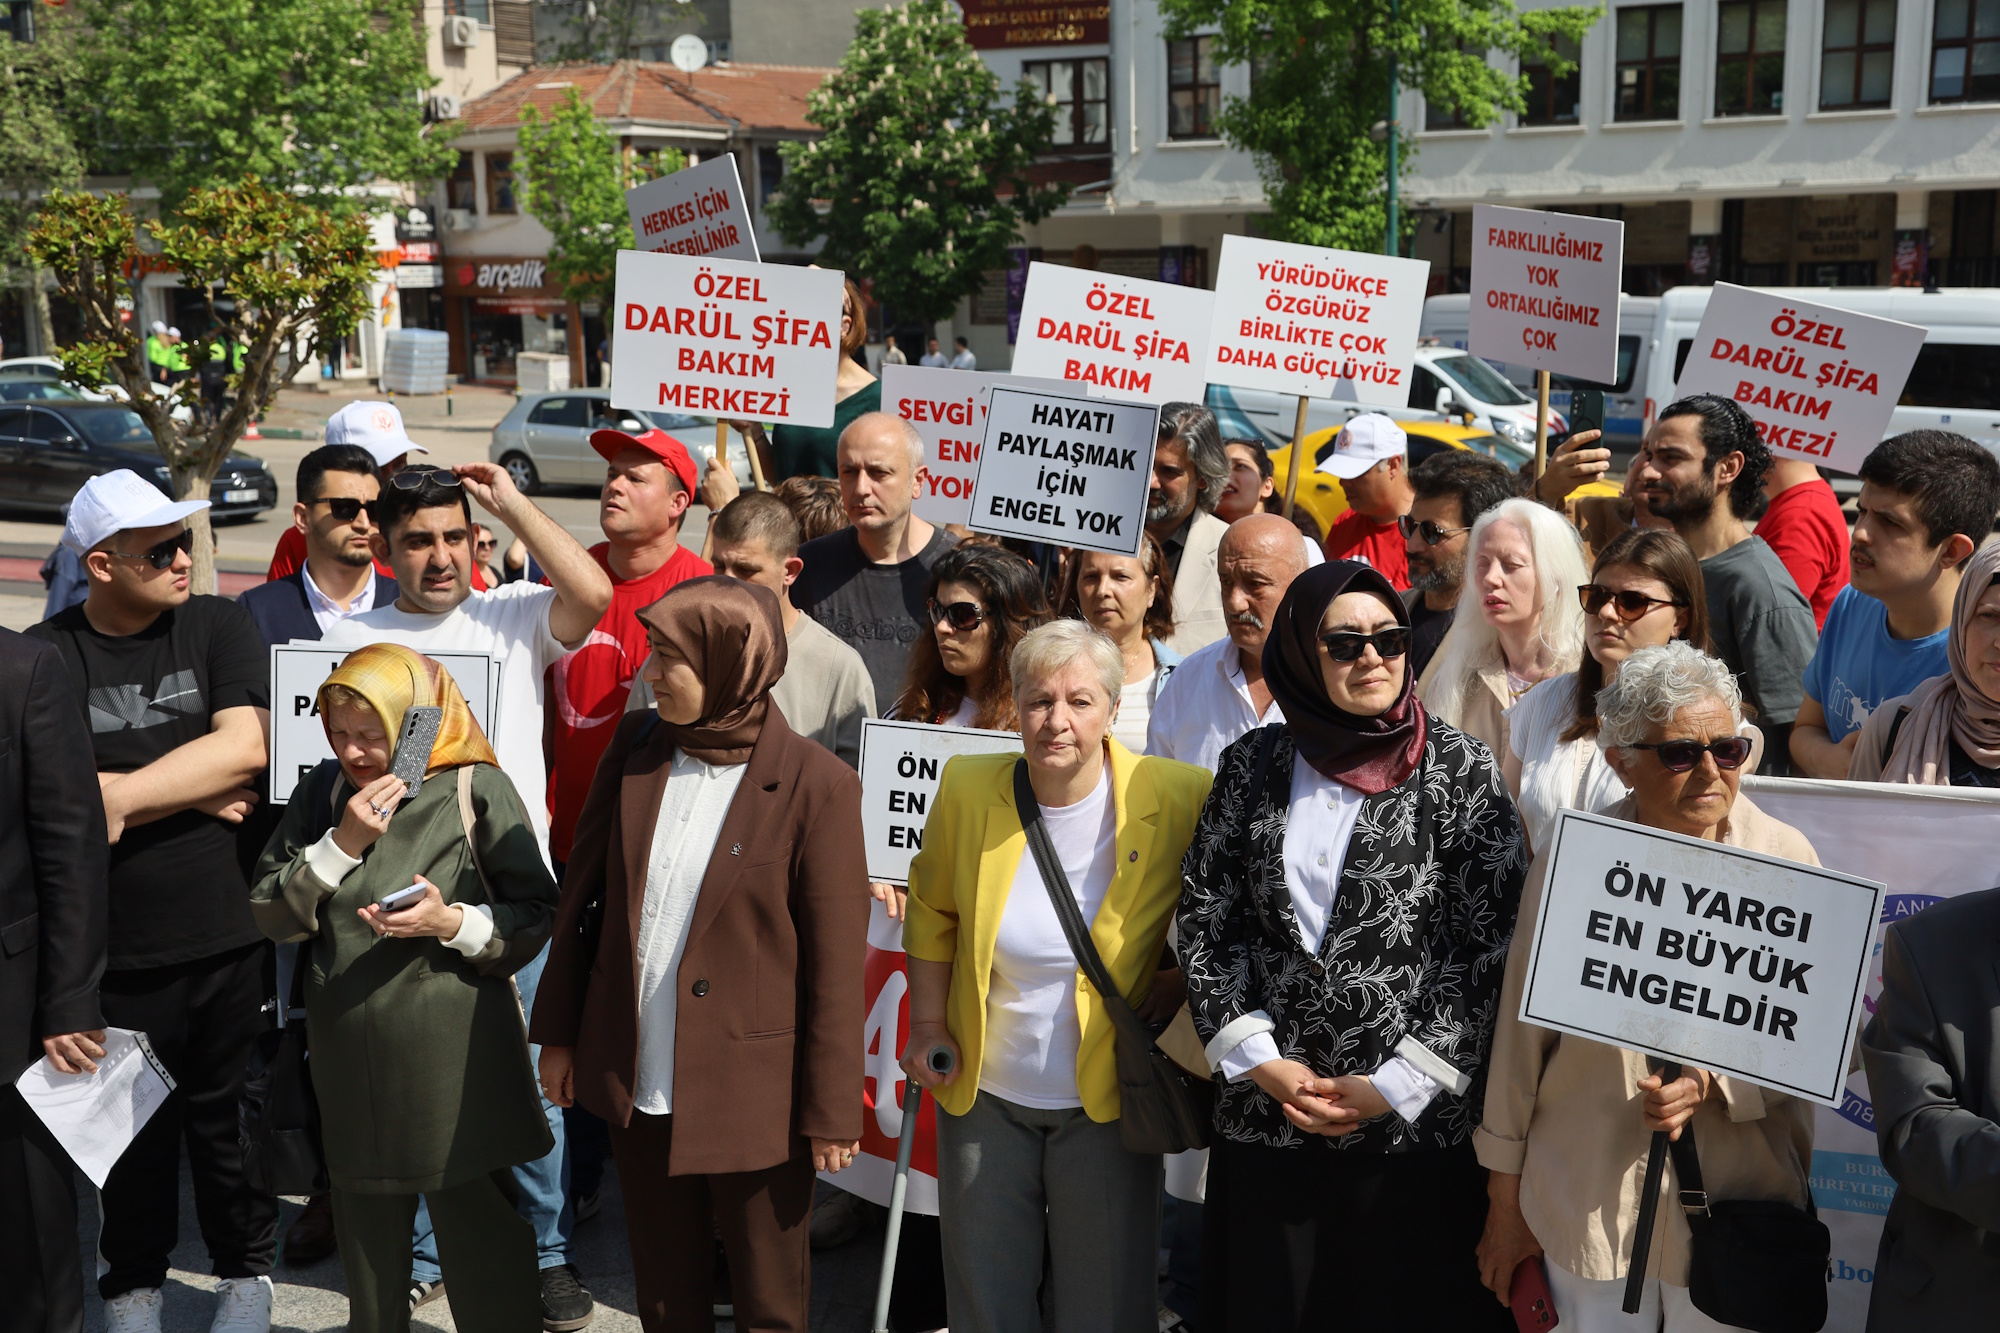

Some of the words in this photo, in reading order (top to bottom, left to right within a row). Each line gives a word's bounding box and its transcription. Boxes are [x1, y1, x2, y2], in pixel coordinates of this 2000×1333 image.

[641, 201, 696, 236] HERKES
[694, 187, 730, 220] İÇİN
[649, 220, 740, 256] İEBİLİNİR
[1487, 227, 1604, 262] FARKLILIĞIMIZ
[478, 259, 545, 294] arçelik
[693, 266, 768, 302] ÖZEL
[1257, 259, 1389, 298] YÜRÜDÜKÇE
[1526, 264, 1559, 288] YOK
[1085, 281, 1156, 320] ÖZEL
[1265, 287, 1371, 324] ÖZGÜRÜZ
[1486, 289, 1600, 327] ORTAKLIĞIMIZ
[625, 301, 741, 340] DARÜL
[752, 309, 832, 351] ŞİFA
[1036, 316, 1126, 352] DARÜL
[1132, 329, 1190, 364] ŞİFA
[1239, 315, 1335, 348] BİRLİKTE
[1339, 332, 1388, 356] ÇOK
[1522, 327, 1557, 351] ÇOK
[1770, 307, 1847, 351] ÖZEL
[677, 347, 775, 380] BAKIM
[1063, 358, 1152, 393] BAKIM
[1217, 345, 1278, 370] DAHA
[1283, 351, 1402, 387] GÜÇLÜYÜZ
[1710, 337, 1808, 380] DARÜL
[1815, 359, 1879, 396] ŞİFA
[658, 381, 791, 418] MERKEZİ
[898, 397, 974, 426] SEVGİ
[1733, 380, 1833, 421] BAKIM
[1031, 403, 1115, 434] HAYATI
[997, 431, 1138, 471] PAYLAŞMAK
[1754, 420, 1838, 458] RKEZİ
[1036, 470, 1087, 498] İÇİN
[989, 495, 1066, 527] ENGEL
[1075, 508, 1124, 537] YOK
[897, 751, 939, 781] ÖN
[888, 790, 926, 815] EN
[1604, 860, 1667, 907] ÖN
[1681, 882, 1813, 944] YARGI
[1895, 900, 1934, 916] AN
[1585, 909, 1644, 950] EN
[1655, 925, 1814, 995] BÜYÜK
[1580, 957, 1798, 1042] ENGELDİR
[1808, 1174, 1894, 1198] BİREYLER
